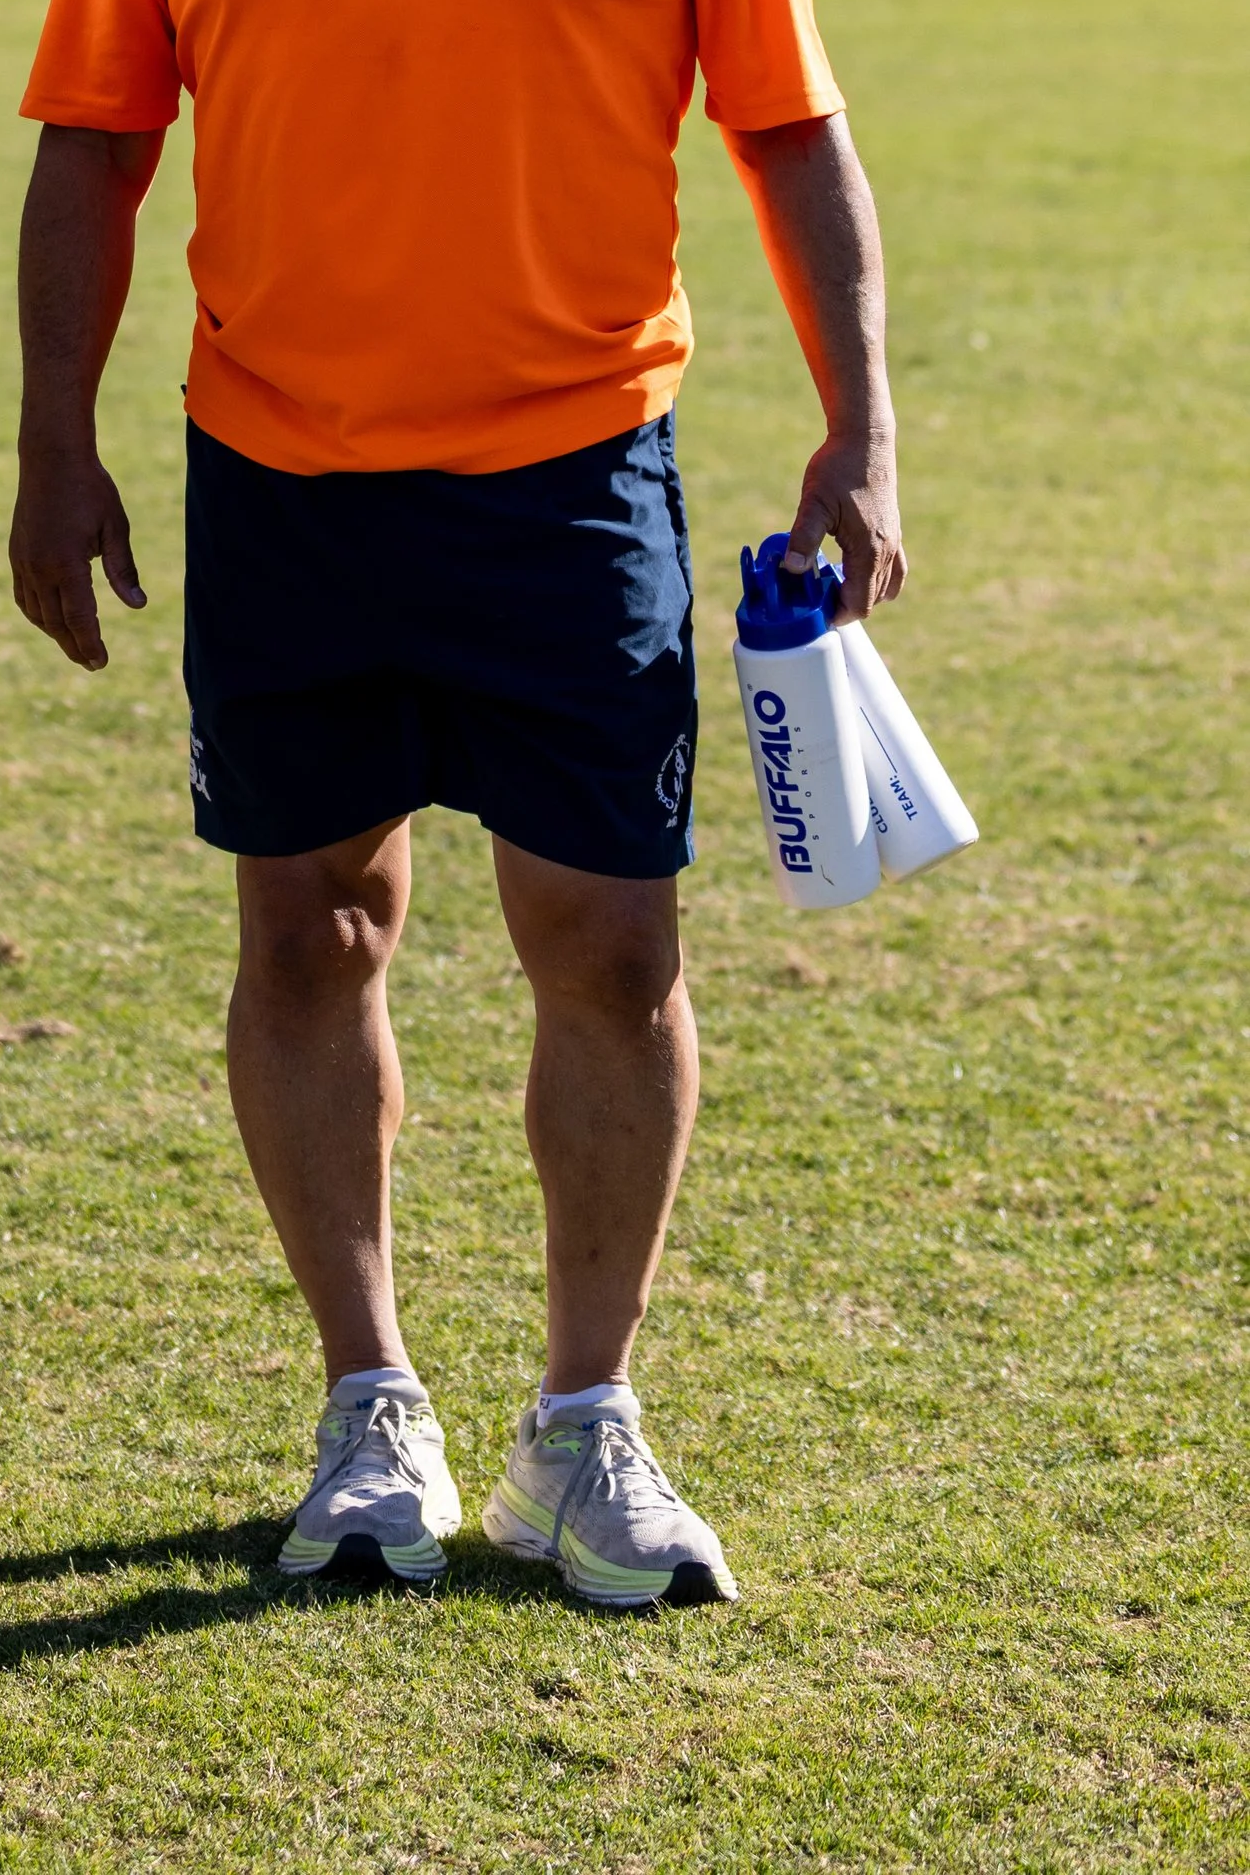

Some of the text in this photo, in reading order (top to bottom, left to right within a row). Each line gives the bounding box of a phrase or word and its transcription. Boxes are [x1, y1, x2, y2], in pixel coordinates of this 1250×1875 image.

[753, 690, 813, 873] BUFFALO
[793, 727, 820, 840] SPORTS
[889, 775, 918, 821] TEAM:
[540, 1397, 551, 1410] FJ
